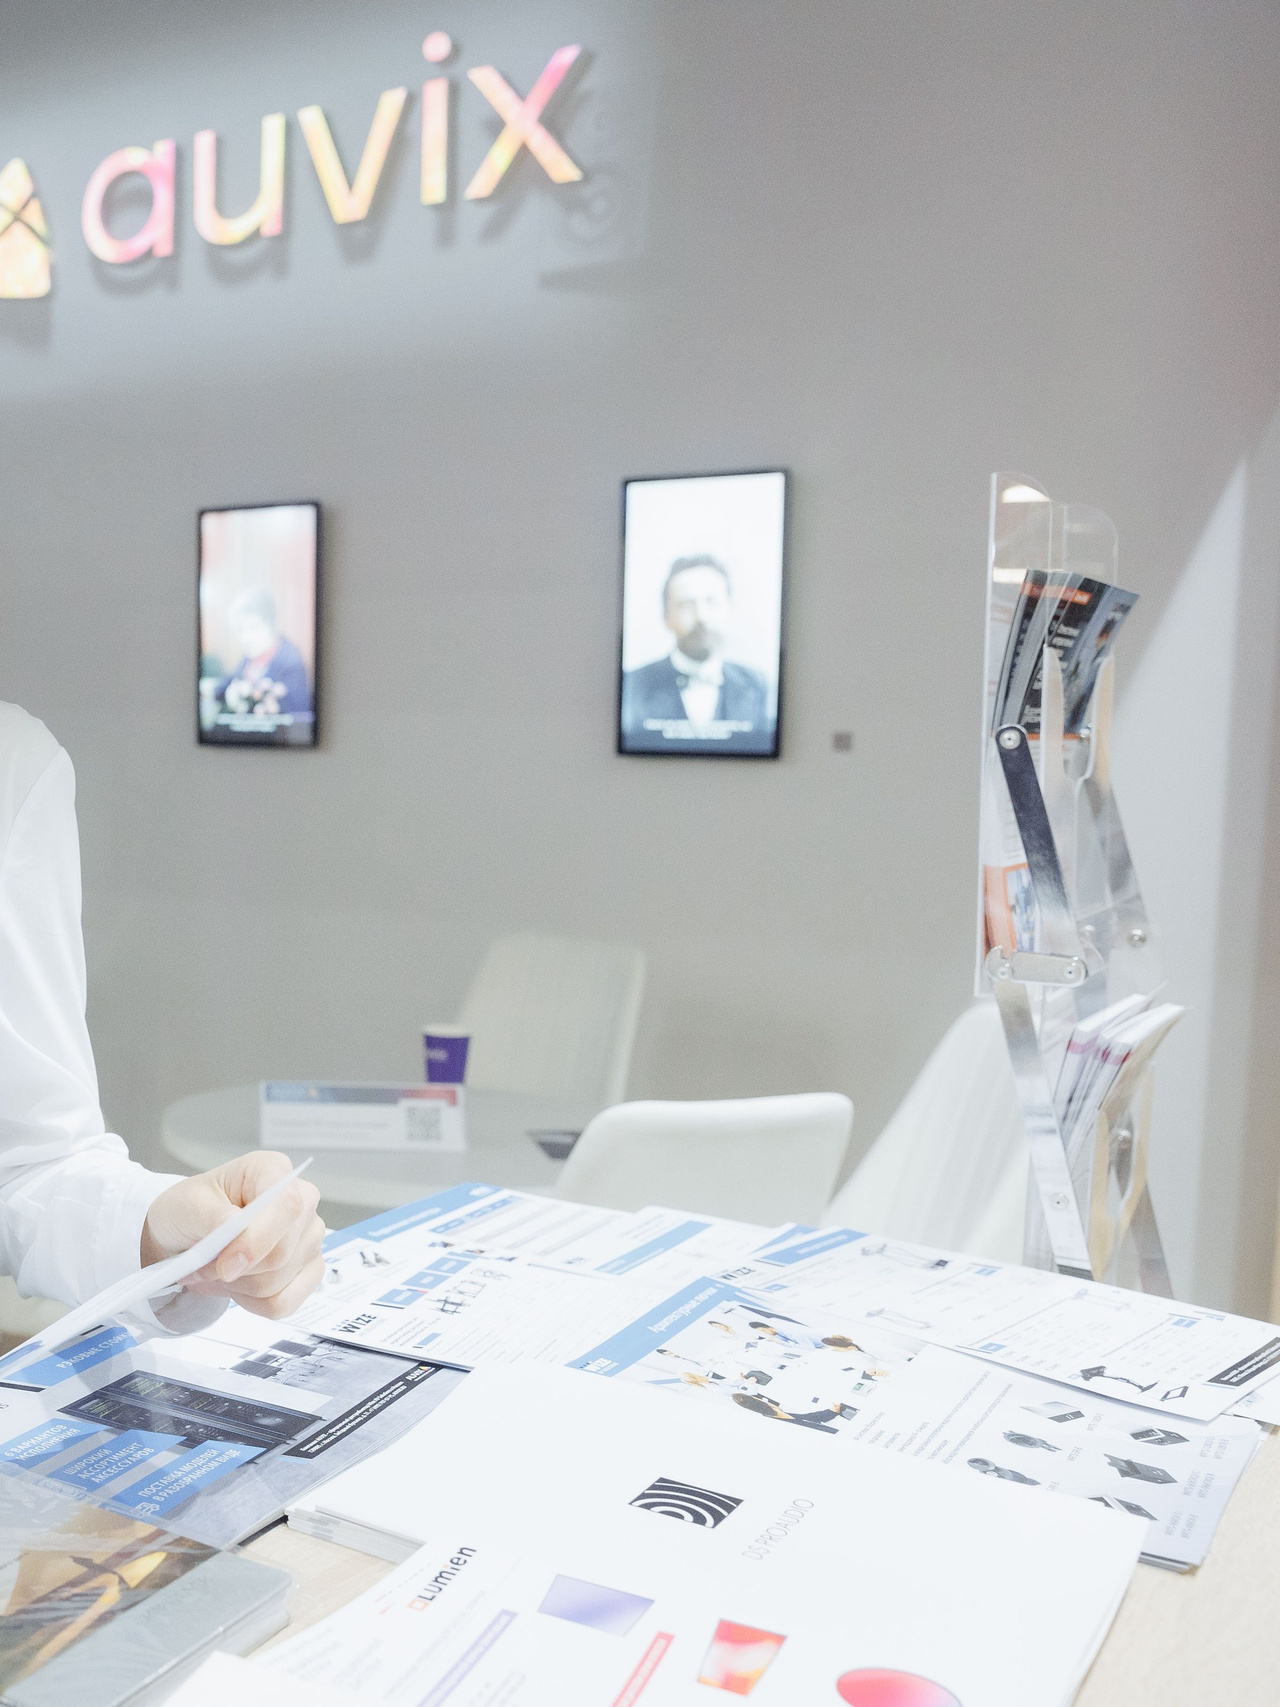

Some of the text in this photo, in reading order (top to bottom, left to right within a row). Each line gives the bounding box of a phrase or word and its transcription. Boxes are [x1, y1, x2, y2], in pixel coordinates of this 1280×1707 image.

[81, 31, 583, 265] auvix
[338, 1313, 377, 1333] WIZE
[10, 1424, 67, 1454] ВАРИАНТОВ
[16, 1427, 81, 1461] ИСПОЛНЕНИЯ
[63, 1447, 113, 1475] ШИРОКИЙ
[77, 1442, 143, 1480] АССОРТИМЕНТ
[91, 1447, 155, 1484] АКСЕССУАРОВ
[138, 1448, 220, 1497] ПОСТАВКА МОДЕЛЕЙ
[159, 1459, 222, 1498] РАЗОБРАННОМ
[217, 1448, 241, 1463] ВИДЕ
